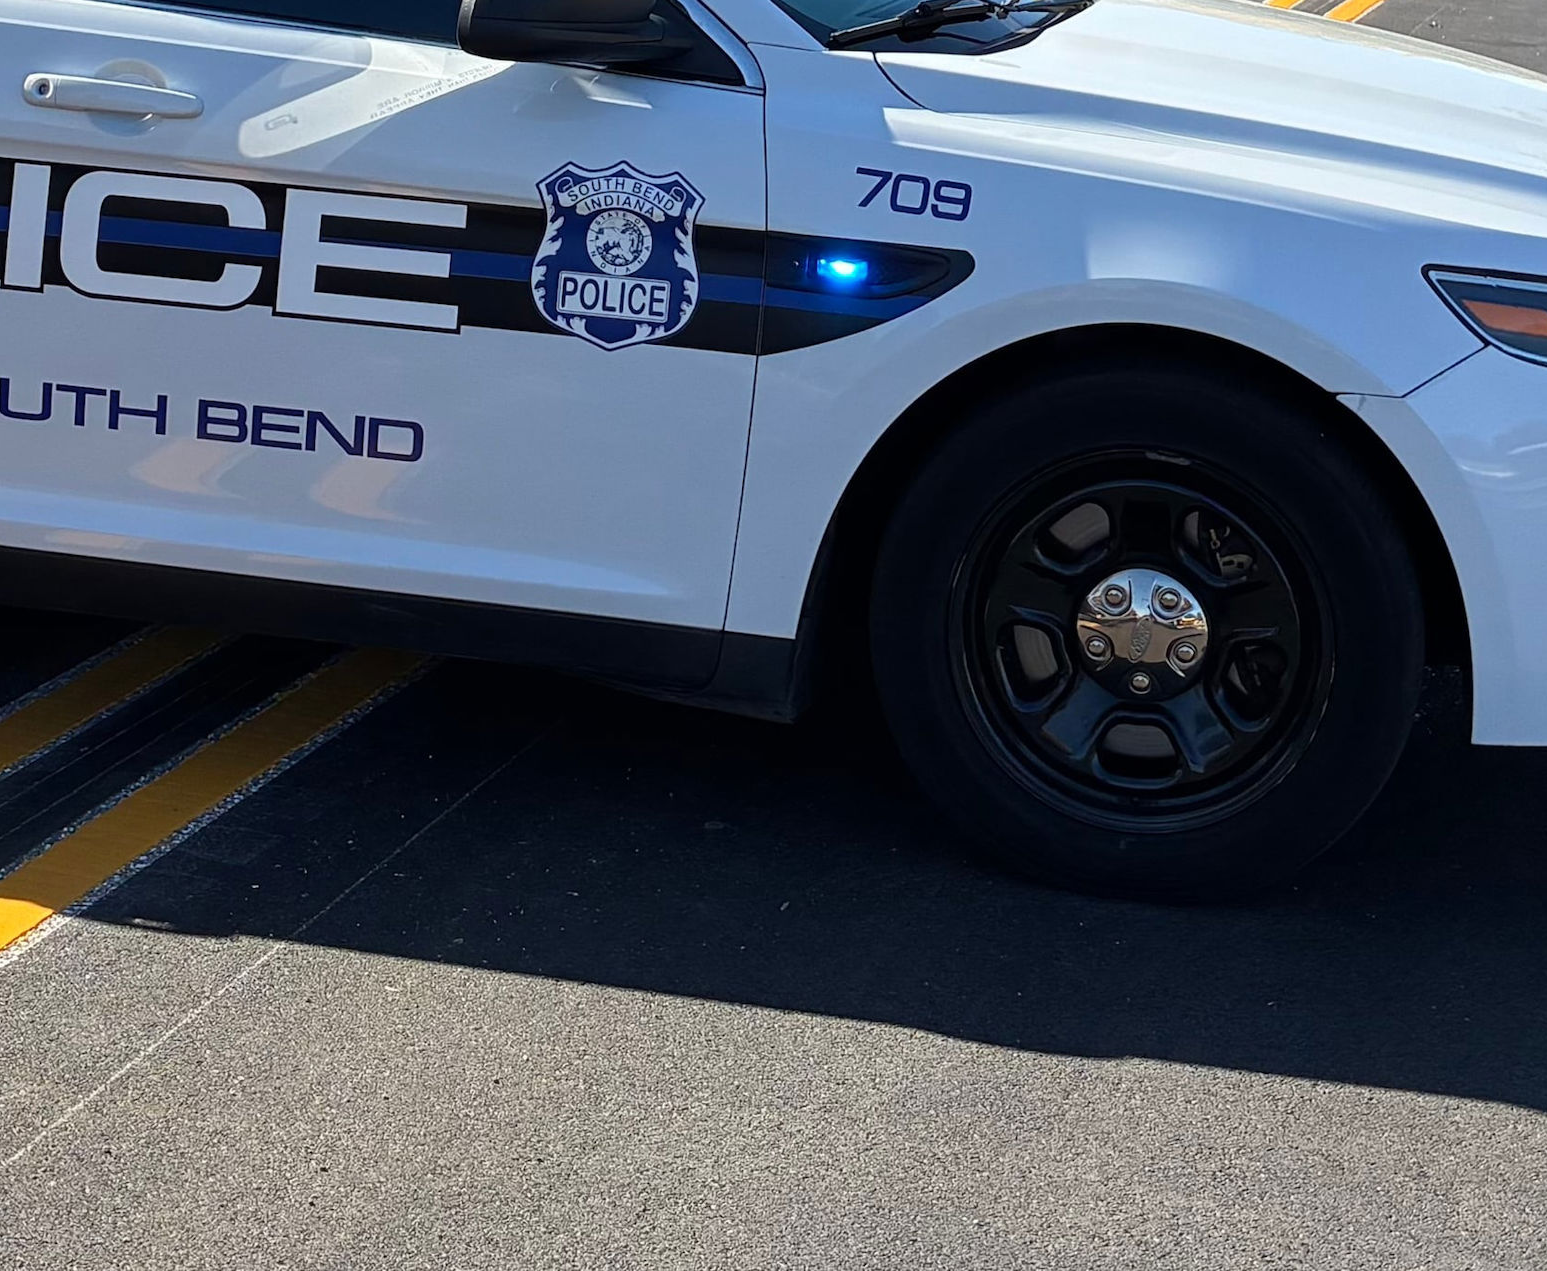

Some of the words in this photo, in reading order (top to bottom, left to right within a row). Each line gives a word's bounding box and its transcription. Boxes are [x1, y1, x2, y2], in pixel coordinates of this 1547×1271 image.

[568, 178, 625, 202] SOUTH
[632, 182, 675, 212] BEND
[585, 195, 655, 218] INDIANA
[854, 166, 974, 221] 709
[595, 212, 627, 226] STATE
[561, 276, 667, 317] POLICE
[197, 397, 424, 463] BEND
